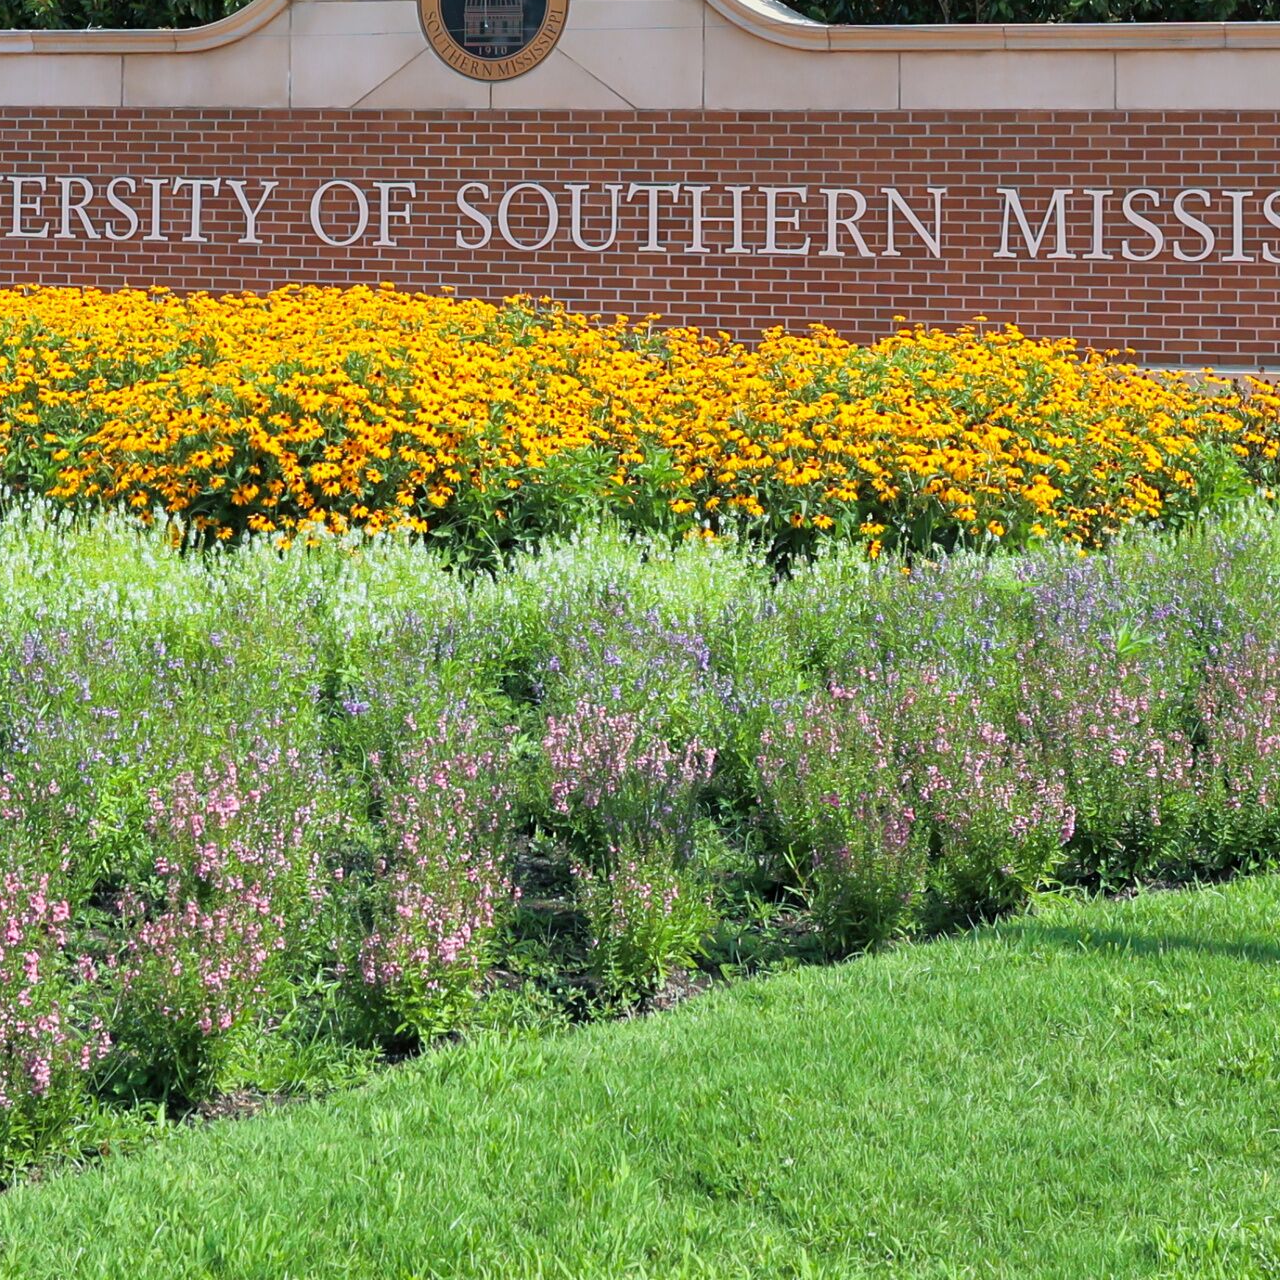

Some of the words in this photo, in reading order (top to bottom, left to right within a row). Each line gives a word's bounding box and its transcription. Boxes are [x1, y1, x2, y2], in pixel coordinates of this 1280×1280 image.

[424, 10, 493, 76] SOUTHERN
[497, 9, 564, 77] MISSISSIPPI
[477, 46, 508, 55] 1910
[310, 179, 417, 248] OF
[455, 181, 947, 260] SOUTHERN
